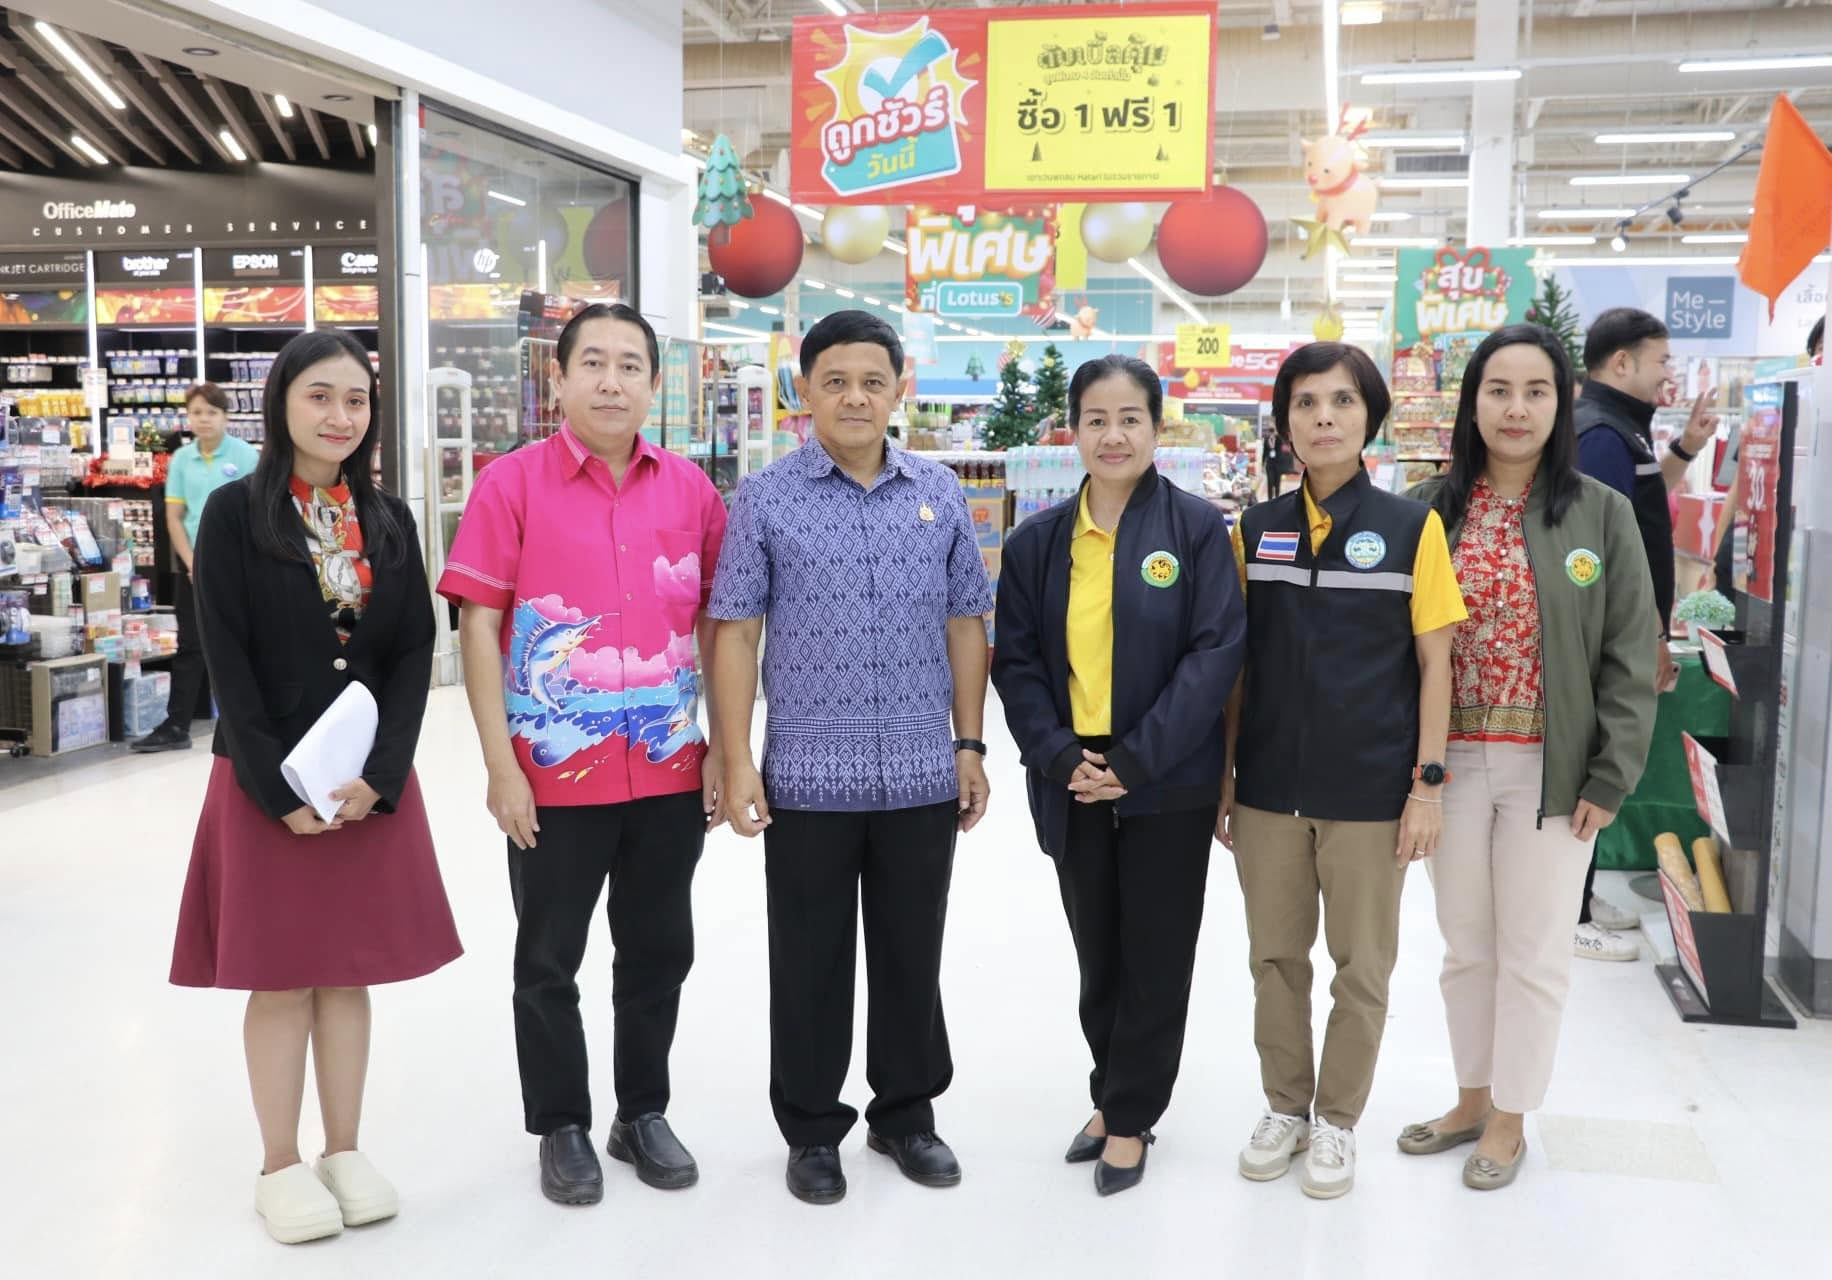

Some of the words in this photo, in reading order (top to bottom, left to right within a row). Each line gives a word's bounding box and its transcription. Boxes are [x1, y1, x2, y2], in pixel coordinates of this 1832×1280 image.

[1017, 88, 1061, 129] ซื้อ
[1074, 103, 1088, 128] 1
[1102, 97, 1150, 128] ฟรี
[1163, 102, 1176, 127] 1
[827, 88, 945, 161] ถูกชัวร์
[867, 135, 918, 179] วันนี้
[43, 200, 136, 219] OfficeMate
[32, 224, 192, 236] CUSTOMER
[226, 220, 367, 232] SERVICE
[908, 217, 1053, 276] พิเศษ
[29, 262, 85, 274] CARTRIDGE
[122, 256, 169, 271] brother
[232, 254, 278, 269] EPSON
[947, 290, 1014, 307] Lotus's
[1672, 291, 1704, 309] Me
[1671, 310, 1726, 333] Style
[1197, 338, 1219, 354] 200
